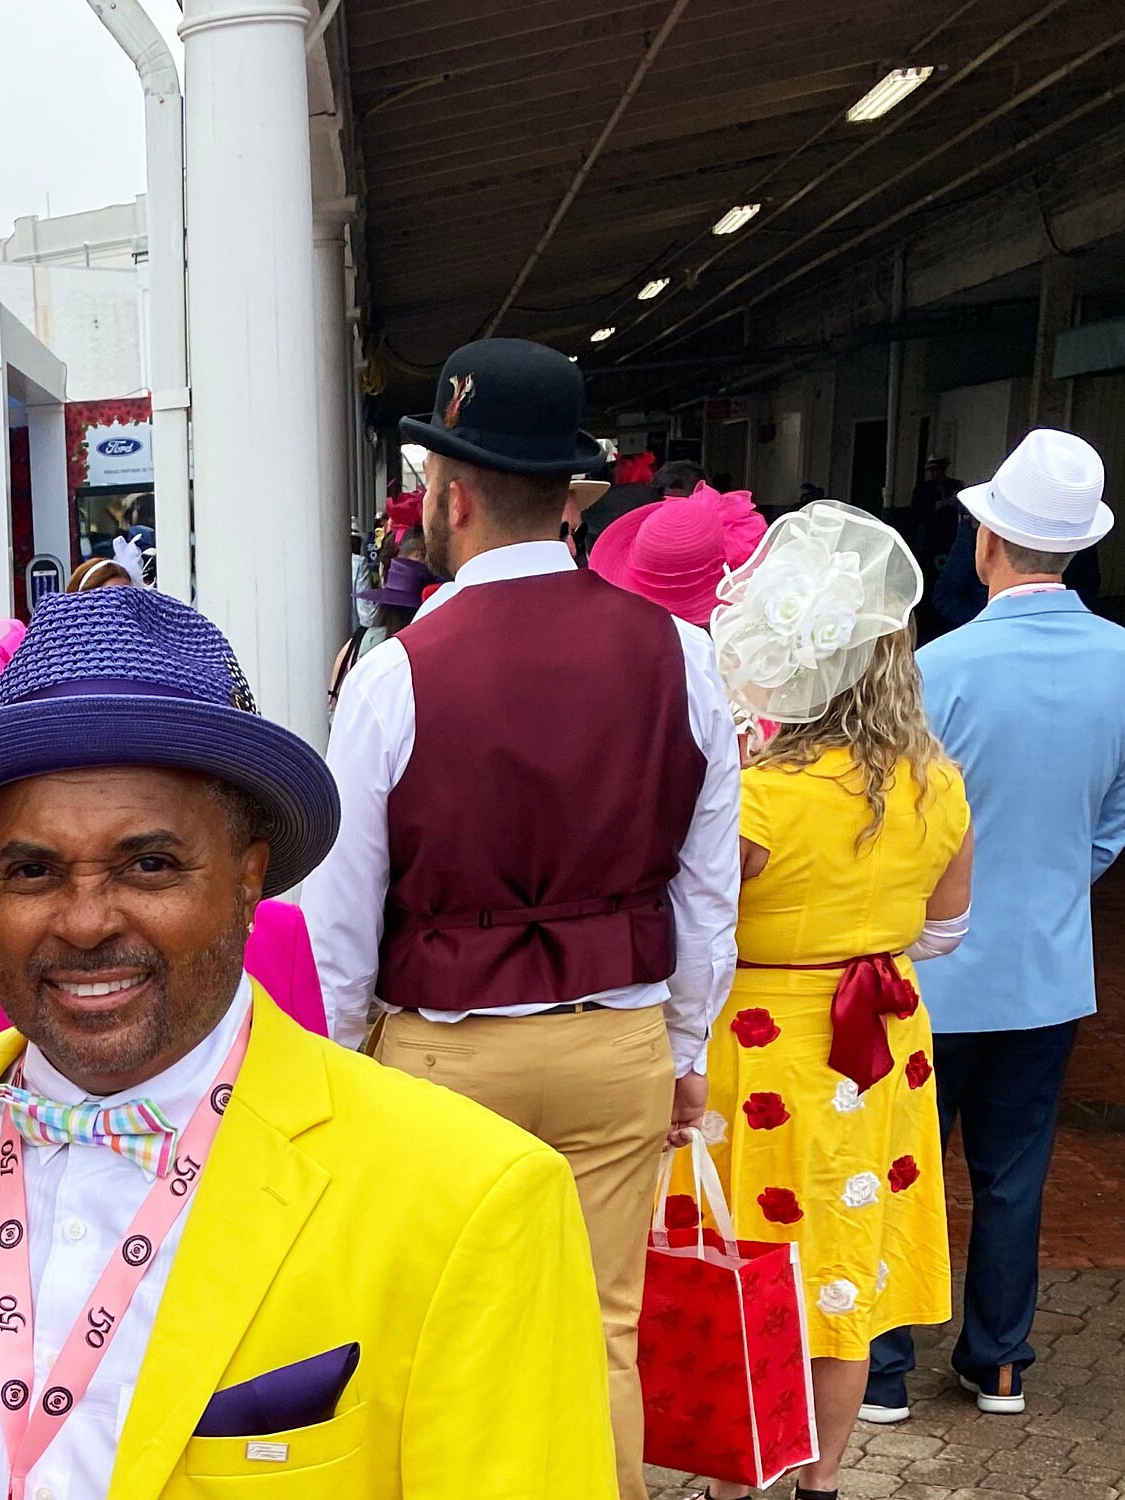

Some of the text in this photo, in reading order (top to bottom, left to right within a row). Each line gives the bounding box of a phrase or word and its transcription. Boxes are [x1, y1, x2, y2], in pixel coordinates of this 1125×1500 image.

[106, 440, 134, 454] Ford
[0, 1139, 19, 1176] 150
[169, 1153, 202, 1198] 150
[0, 1294, 27, 1333] 150
[85, 1305, 115, 1349] 150
